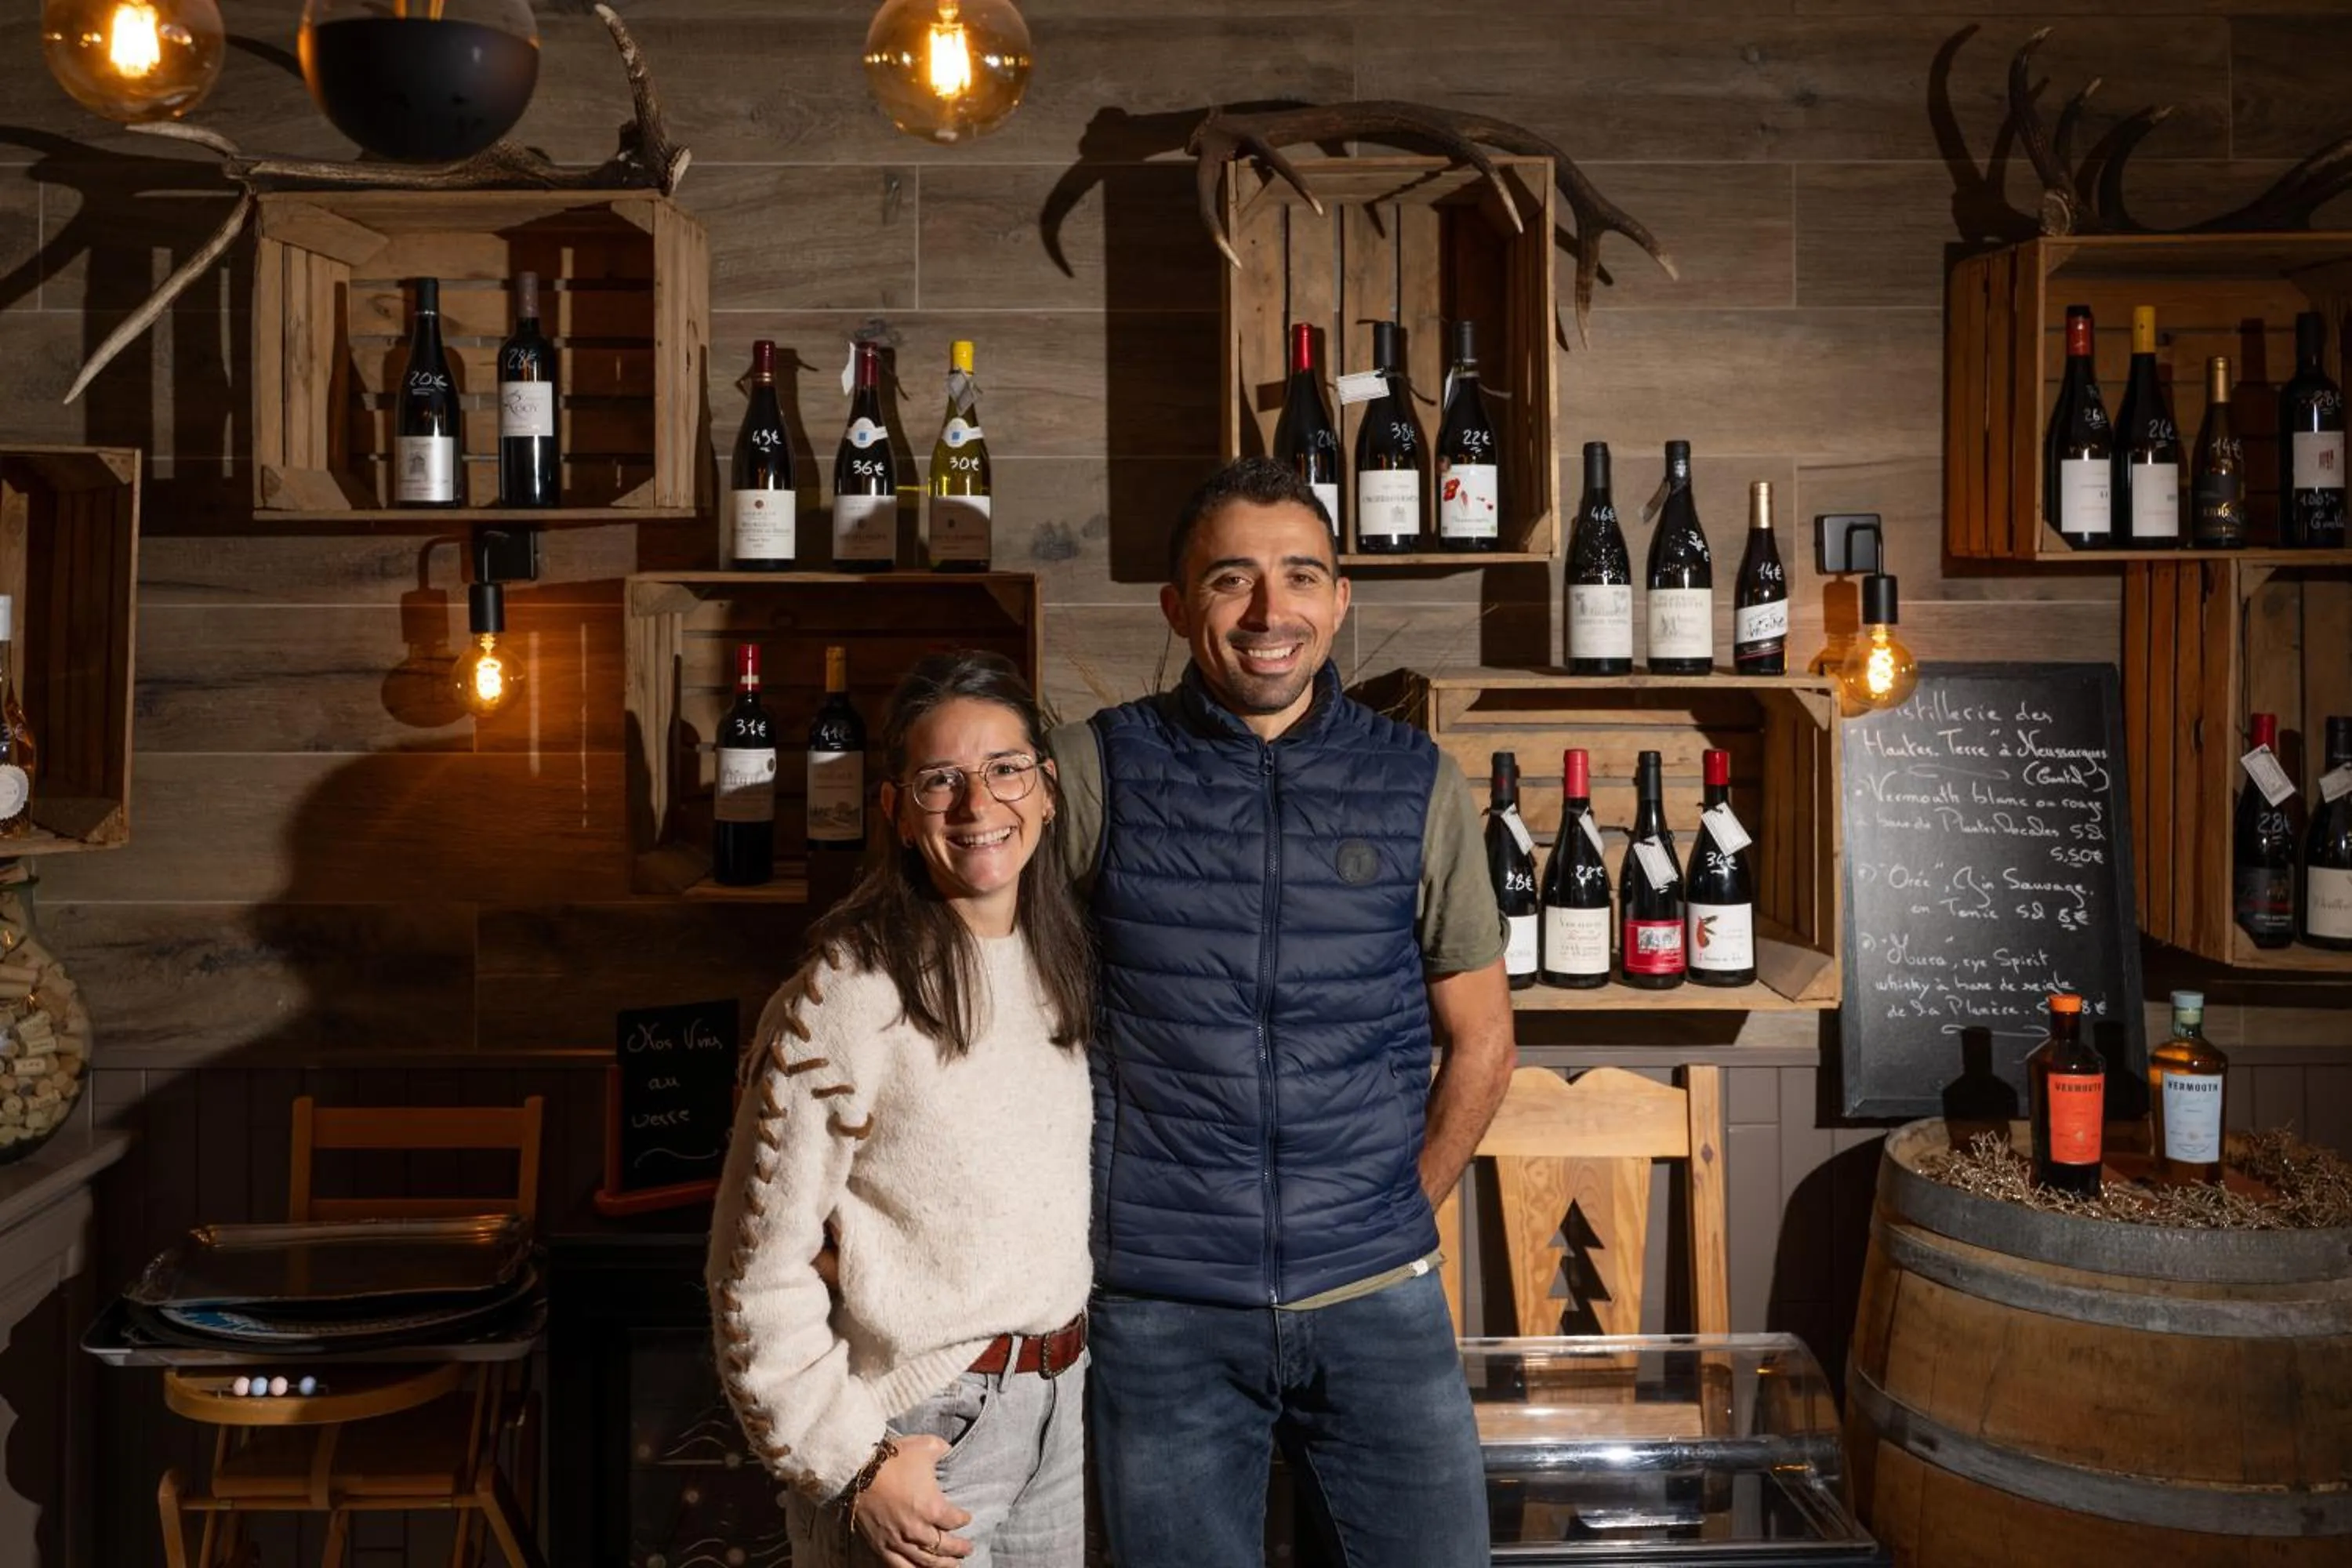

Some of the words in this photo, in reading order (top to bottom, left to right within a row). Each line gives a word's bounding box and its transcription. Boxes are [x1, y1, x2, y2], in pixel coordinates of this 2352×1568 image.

[1463, 429, 1491, 446] 22€
[852, 459, 884, 477] 36€
[950, 456, 979, 472] 30€
[1896, 690, 2002, 723] istillerie
[2054, 1081, 2102, 1094] VERMOUTH
[2168, 1080, 2219, 1093] VERMOUTH
